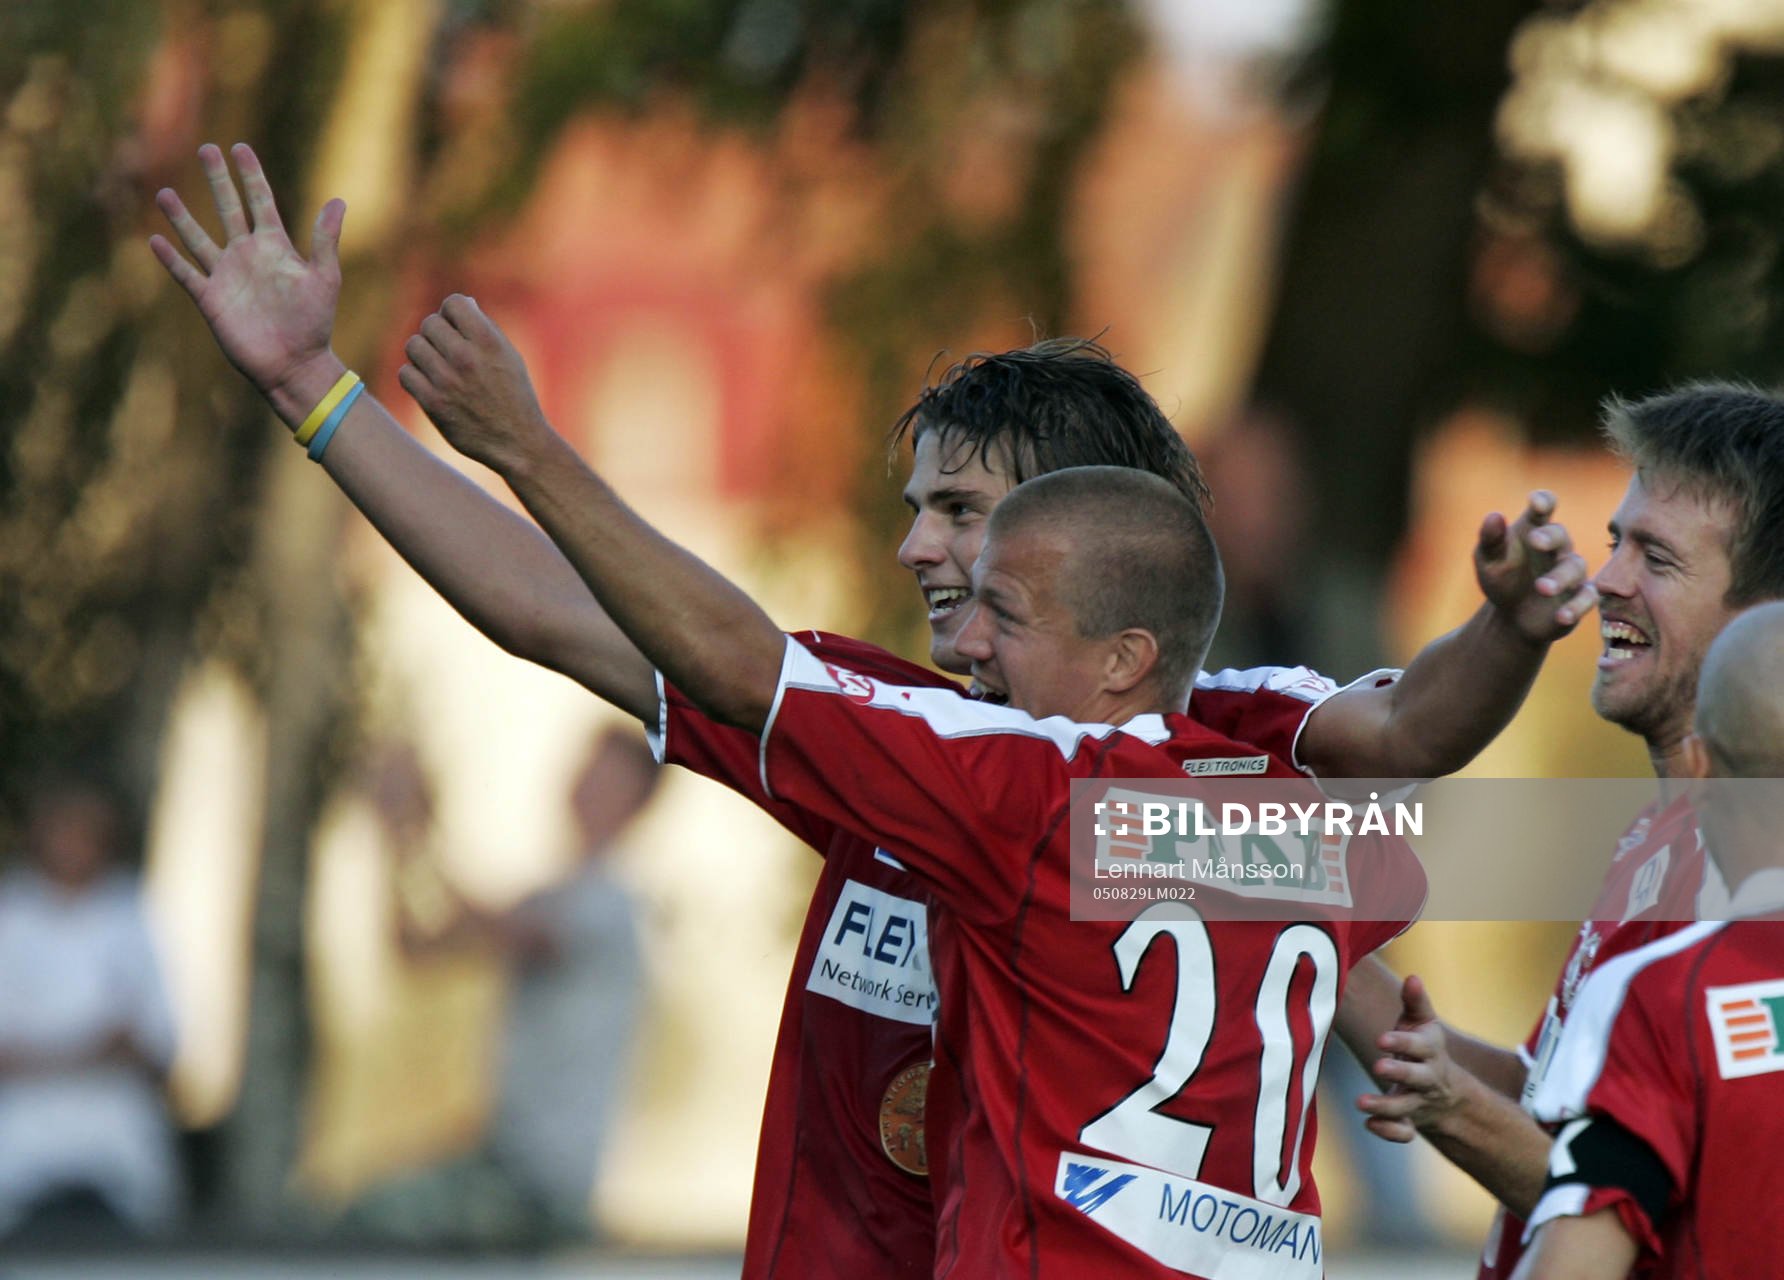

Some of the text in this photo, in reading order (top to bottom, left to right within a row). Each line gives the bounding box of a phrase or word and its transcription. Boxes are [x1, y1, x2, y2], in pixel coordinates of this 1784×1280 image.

[820, 957, 899, 1002] Network
[1078, 899, 1340, 1209] 20
[1159, 1183, 1321, 1264] MOTOMAN
